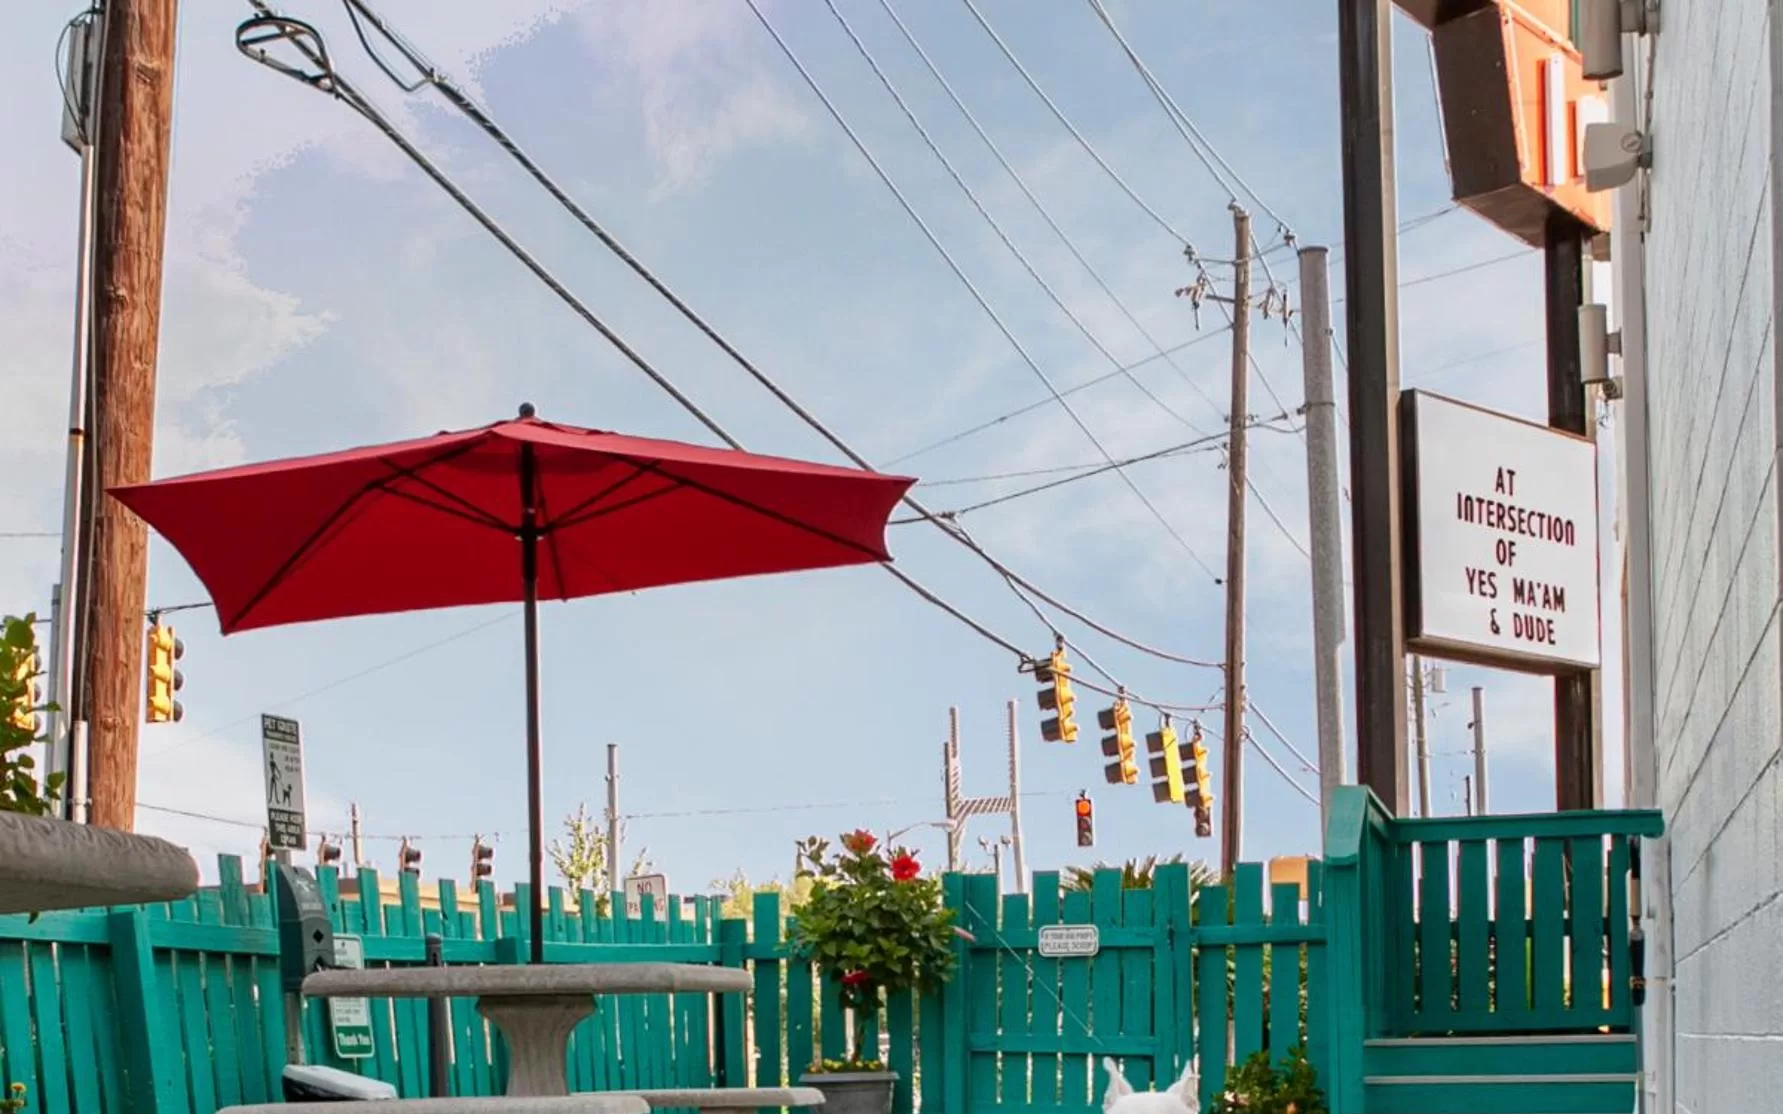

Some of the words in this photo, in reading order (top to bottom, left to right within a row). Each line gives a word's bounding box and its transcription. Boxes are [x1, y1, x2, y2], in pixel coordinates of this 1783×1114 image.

[1495, 466, 1516, 496] AT
[1457, 492, 1575, 546] INTERSECTION
[1495, 538, 1516, 567] OF
[1466, 567, 1497, 599] YES
[1512, 577, 1566, 613] MA'AM
[1490, 608, 1500, 635] &
[1513, 612, 1556, 645] DUDE
[636, 881, 653, 895] NO
